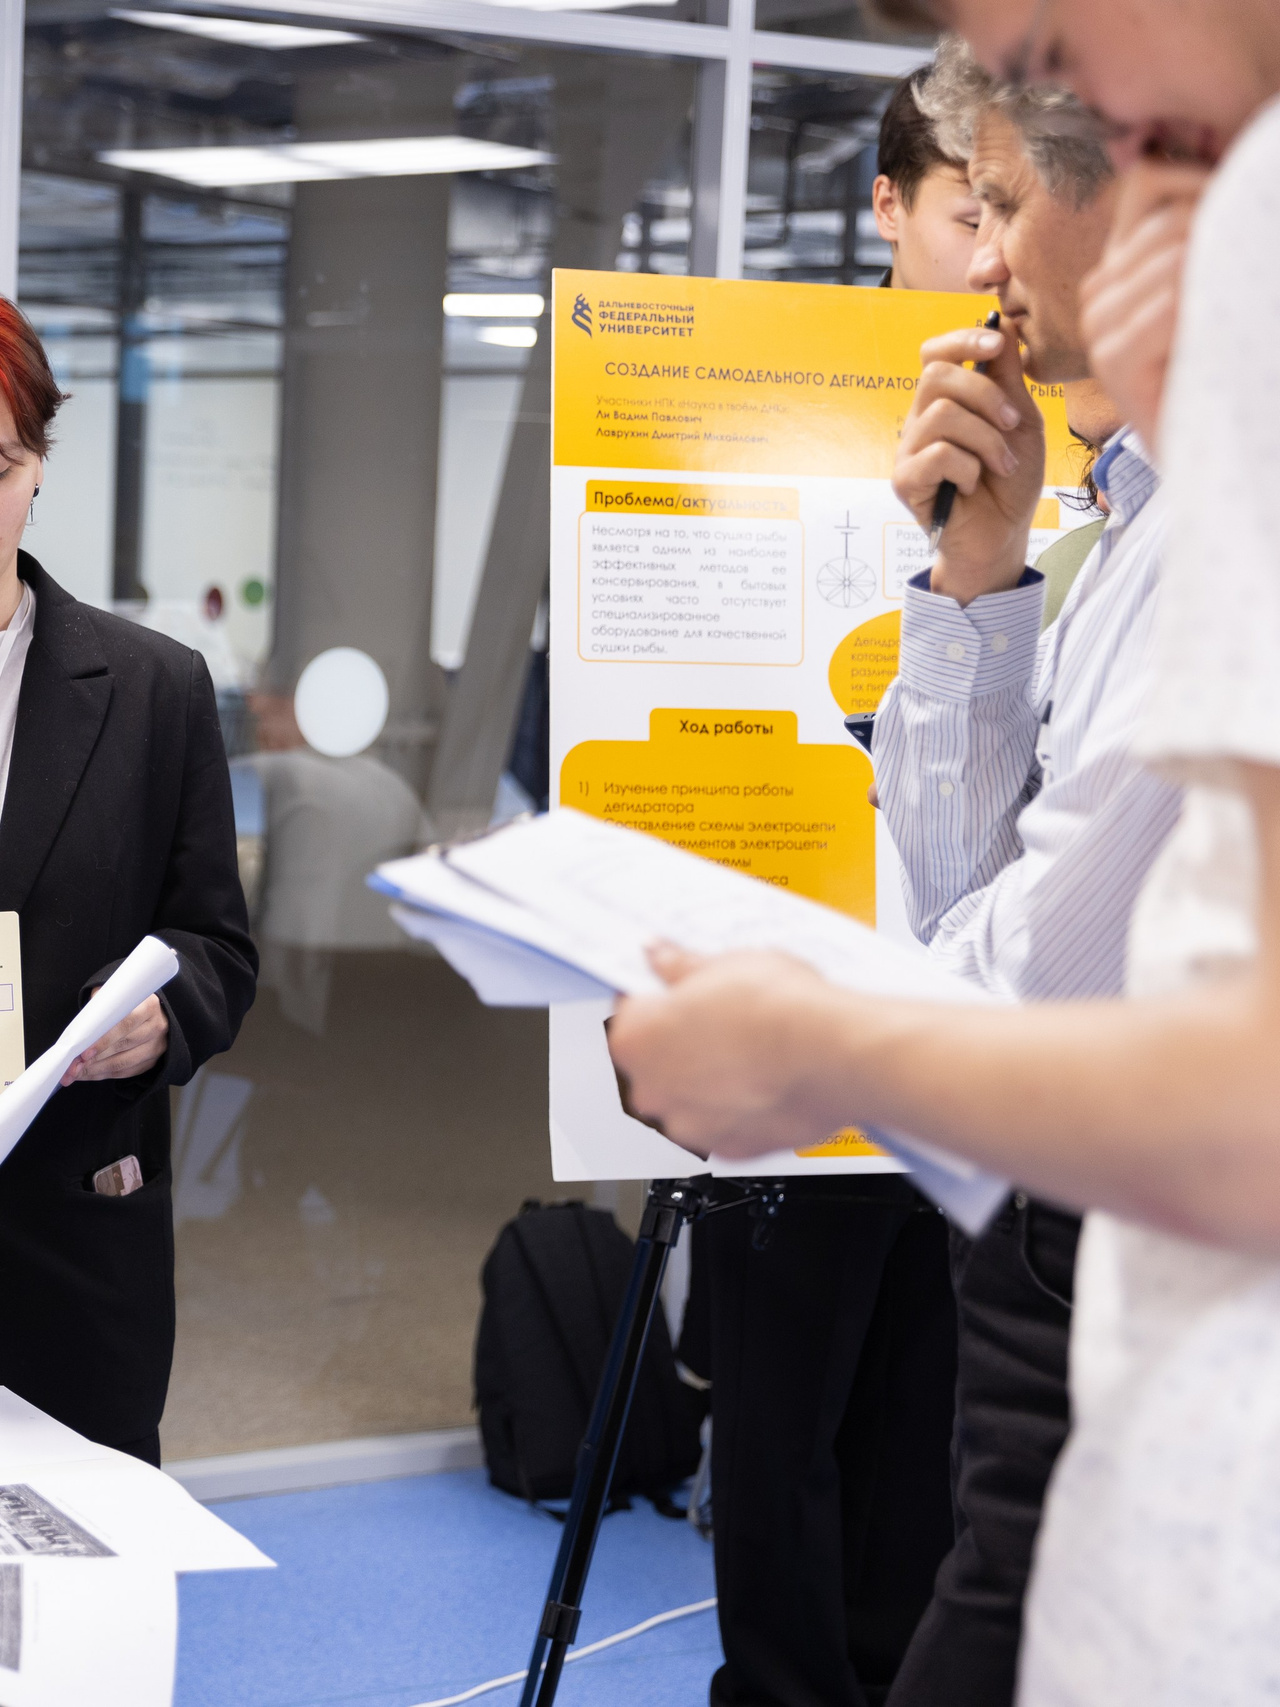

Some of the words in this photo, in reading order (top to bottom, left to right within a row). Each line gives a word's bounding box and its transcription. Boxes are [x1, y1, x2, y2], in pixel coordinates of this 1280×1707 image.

[598, 300, 695, 312] ДАЛЬНЕВОСТОЧНЫЙ
[598, 311, 694, 324] ФЕДЕРАЛЬНЫЙ
[598, 323, 694, 337] УНИВЕРСИТЕТ
[605, 361, 690, 379] СОЗДАНИЕ
[695, 366, 825, 386] САМОДЕЛЬНОГО
[596, 395, 652, 407] Участники
[654, 397, 674, 408] НПК
[596, 410, 610, 420] Ли
[613, 410, 649, 421] Вадим
[652, 412, 702, 423] Павлович
[596, 427, 649, 439] Лаврухин
[651, 430, 700, 442] Дмитрий
[594, 491, 788, 512] Проблема/актуальность
[592, 525, 651, 540] Несмотря
[655, 529, 670, 538] на
[674, 530, 689, 540] то,
[692, 531, 711, 540] что
[714, 532, 753, 543] сушка
[756, 530, 787, 543] рыбы
[592, 544, 640, 554] является
[652, 546, 692, 556] одним
[704, 547, 716, 556] из
[728, 547, 787, 559] наиболее
[592, 559, 676, 572] эффективных
[699, 564, 749, 575] методов
[772, 566, 787, 575] ее
[592, 577, 700, 590] консервирования,
[740, 579, 787, 591] бытовых
[592, 594, 644, 606] условиях
[665, 596, 700, 606] часто
[721, 598, 787, 609] отсутствует
[592, 610, 721, 624] специализированное
[592, 625, 680, 640] оборудование
[683, 630, 703, 639] для
[707, 628, 787, 641] качественной
[592, 643, 630, 654] сушки
[633, 642, 669, 655] рыбы.
[851, 653, 898, 663] которые
[679, 720, 710, 735] Ход
[714, 720, 774, 736] работы
[578, 781, 590, 797] 1)
[603, 782, 668, 797] Изучение
[671, 784, 740, 797] принципа
[743, 783, 794, 797] работы
[603, 802, 694, 815] дегидратора
[699, 820, 745, 832] схемы
[748, 820, 836, 834] электроцепи
[740, 838, 828, 852] электроцепи
